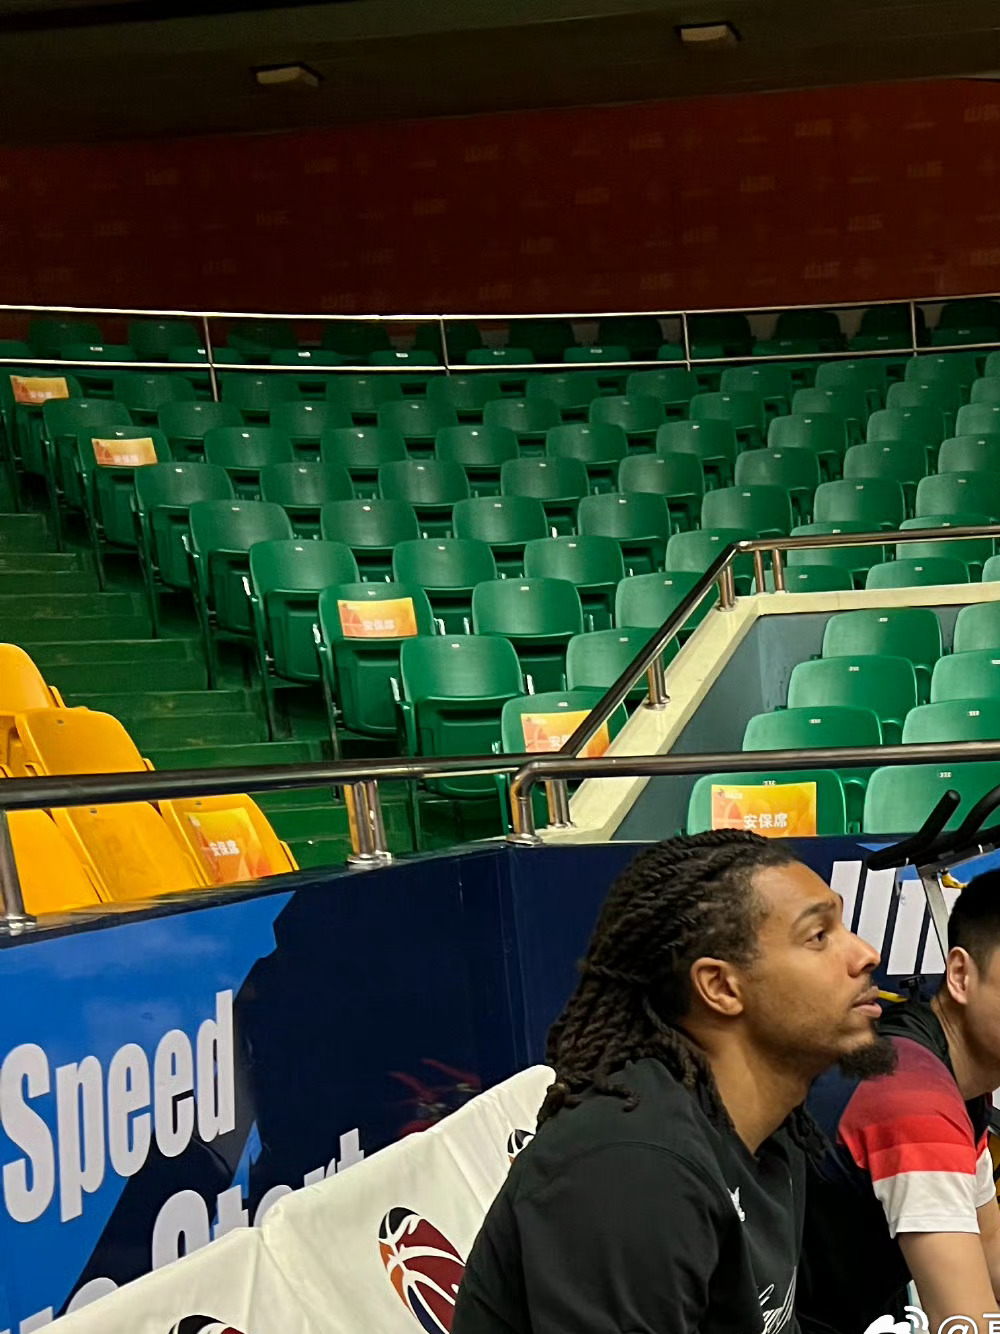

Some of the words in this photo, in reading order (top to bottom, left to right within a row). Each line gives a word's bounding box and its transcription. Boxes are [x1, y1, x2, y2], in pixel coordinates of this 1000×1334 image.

[743, 812, 788, 829] 安保席
[0, 989, 235, 1224] Speed
